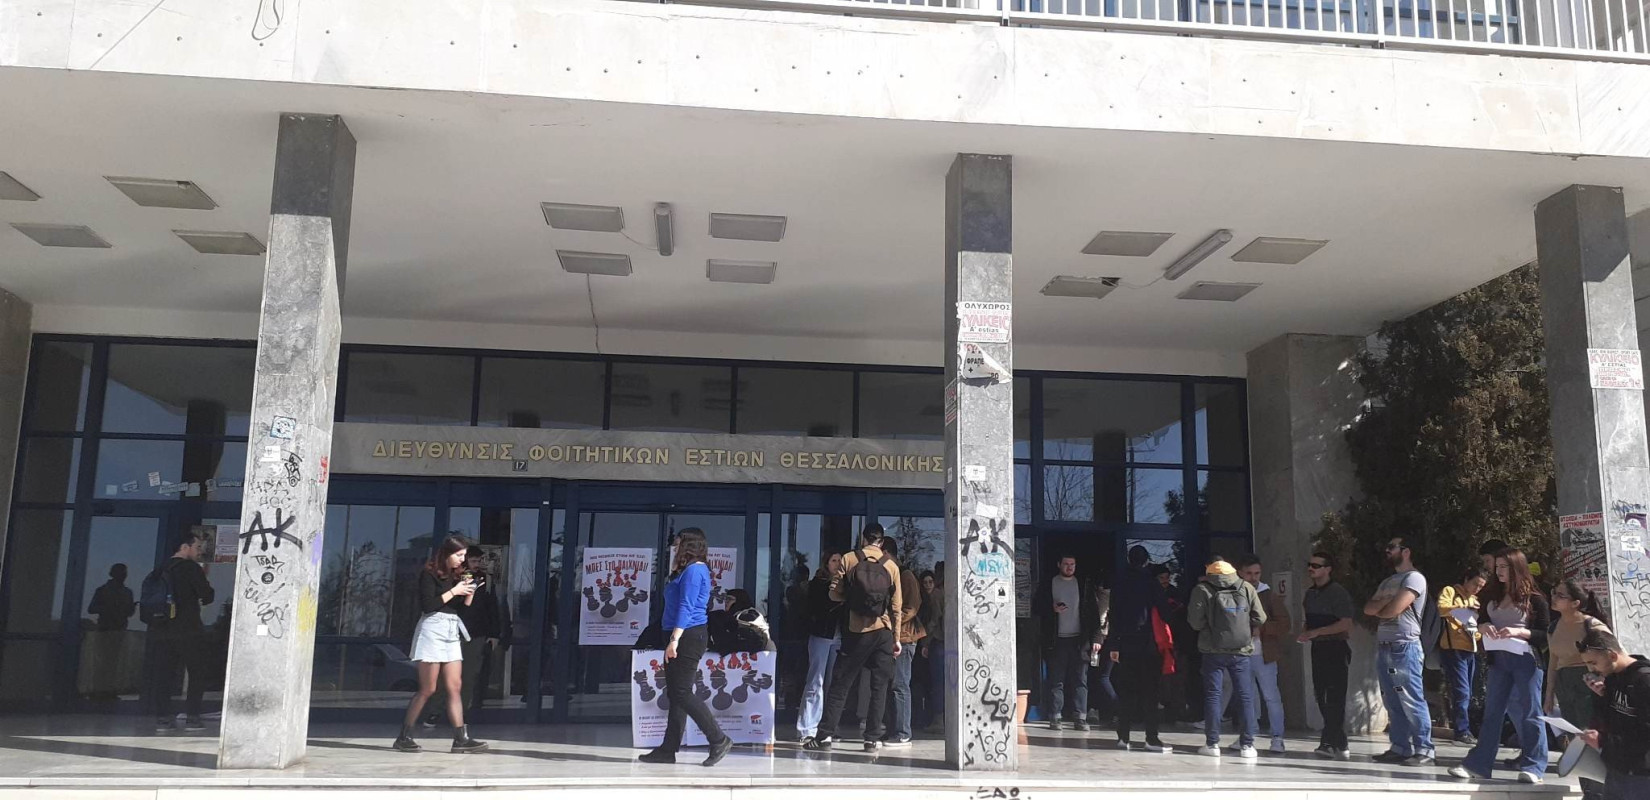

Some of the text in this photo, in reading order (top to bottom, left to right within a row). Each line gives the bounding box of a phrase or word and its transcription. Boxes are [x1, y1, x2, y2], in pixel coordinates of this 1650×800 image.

[372, 440, 944, 472] ΔΙΕΥΘΥΝΣΙΣ ΦΟΙΤΗΤΙΚΩΝ ΕΣΤΙΩΝ ΘΕΣΣΑΛΟΝΙΚΗΣ
[515, 461, 525, 470] 17
[585, 561, 603, 575] ΜΠΕΣ
